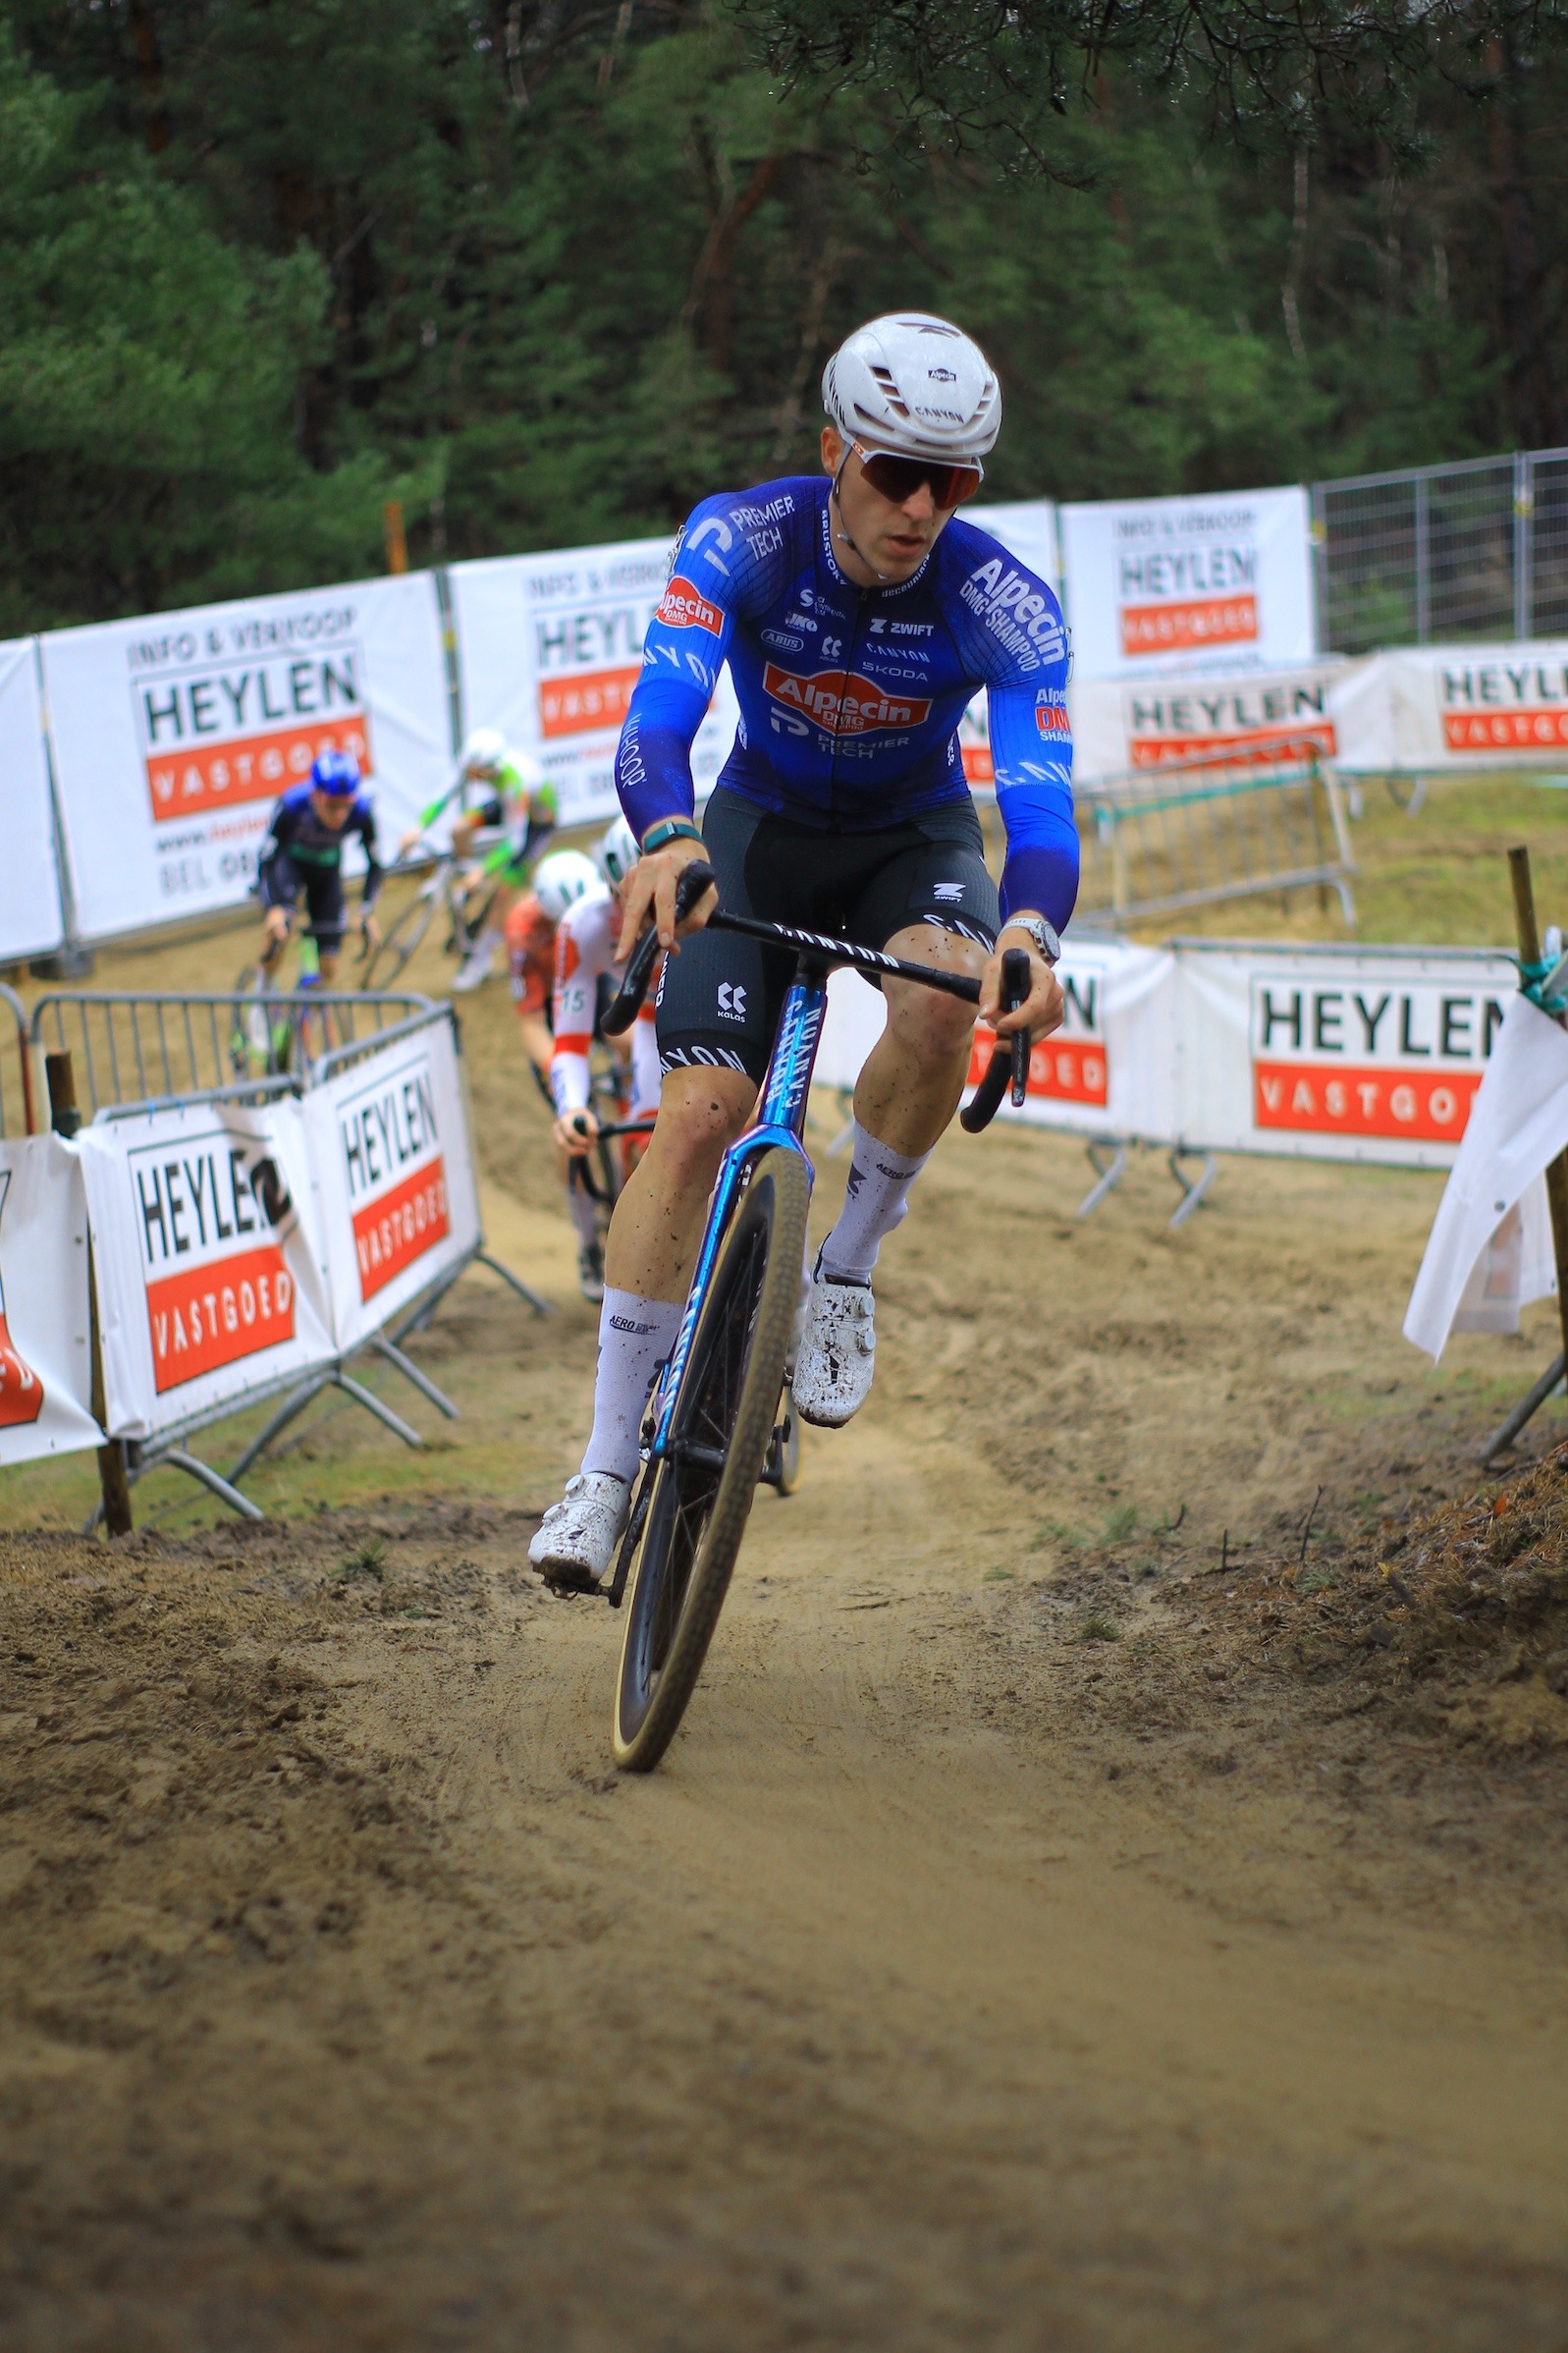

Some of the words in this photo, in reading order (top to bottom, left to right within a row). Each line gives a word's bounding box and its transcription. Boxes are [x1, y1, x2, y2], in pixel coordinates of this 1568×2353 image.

[729, 496, 795, 531] PREMIER
[746, 527, 784, 561] TECH
[1121, 546, 1256, 596] HEYLEN
[660, 591, 714, 626] lpecin
[959, 580, 990, 617] DMG
[985, 608, 1041, 672] SHAMPOO
[970, 559, 1064, 665] Alpecin
[538, 601, 656, 670] HEYL
[767, 632, 799, 649] ABUS
[644, 645, 717, 687] NYO
[1443, 663, 1568, 704] HEYL
[142, 655, 358, 742] HEYLEN
[776, 679, 911, 722] Alpecin
[1133, 683, 1325, 731] HEYLEN
[1035, 707, 1071, 733] DM
[1040, 731, 1072, 743] SHAM
[818, 734, 909, 749] PREMIER
[818, 741, 873, 759] TECH
[1260, 1074, 1478, 1126] VASTGO
[343, 1071, 439, 1198] HEYLEN
[153, 1271, 292, 1360] VASTGOED
[610, 1315, 636, 1330] AERO
